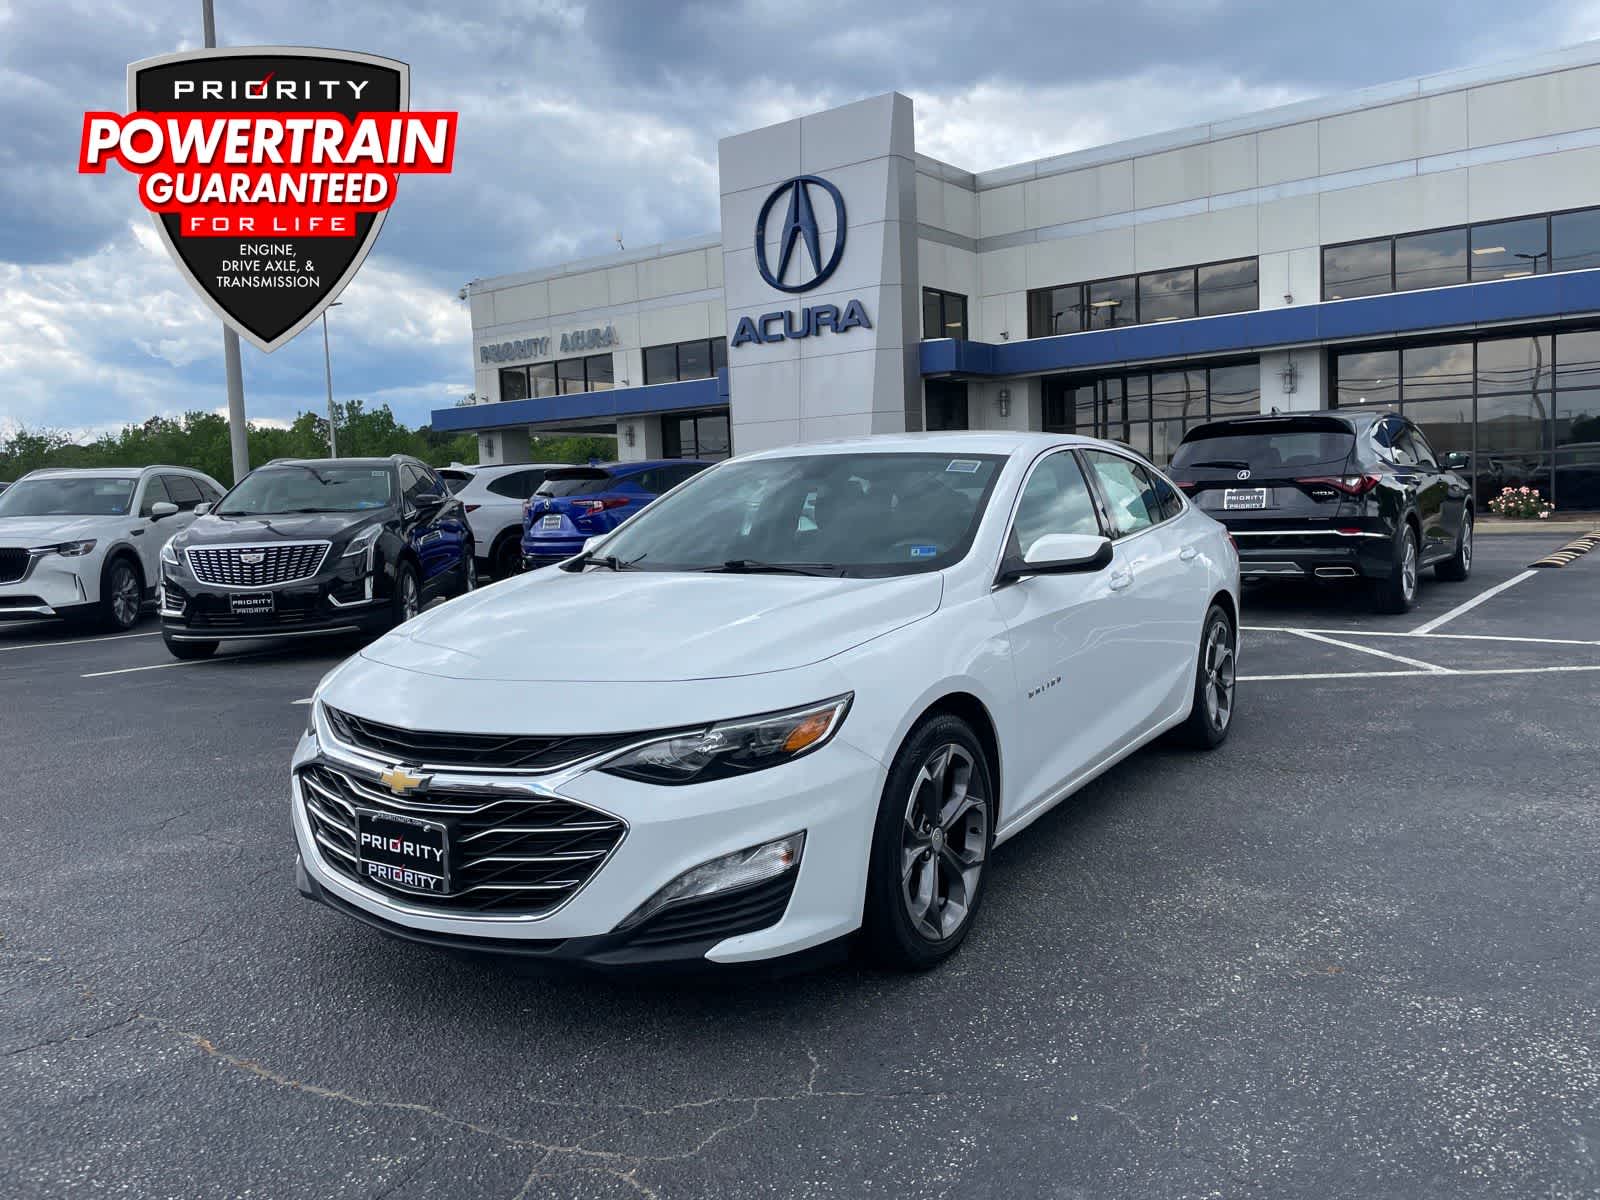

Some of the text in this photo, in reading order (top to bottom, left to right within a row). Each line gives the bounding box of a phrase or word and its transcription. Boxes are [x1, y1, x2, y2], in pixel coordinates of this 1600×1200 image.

[731, 299, 873, 347] ACURA
[559, 325, 617, 353] ACURA
[360, 833, 444, 862] PRIORITY
[368, 863, 437, 889] PRIORITY
